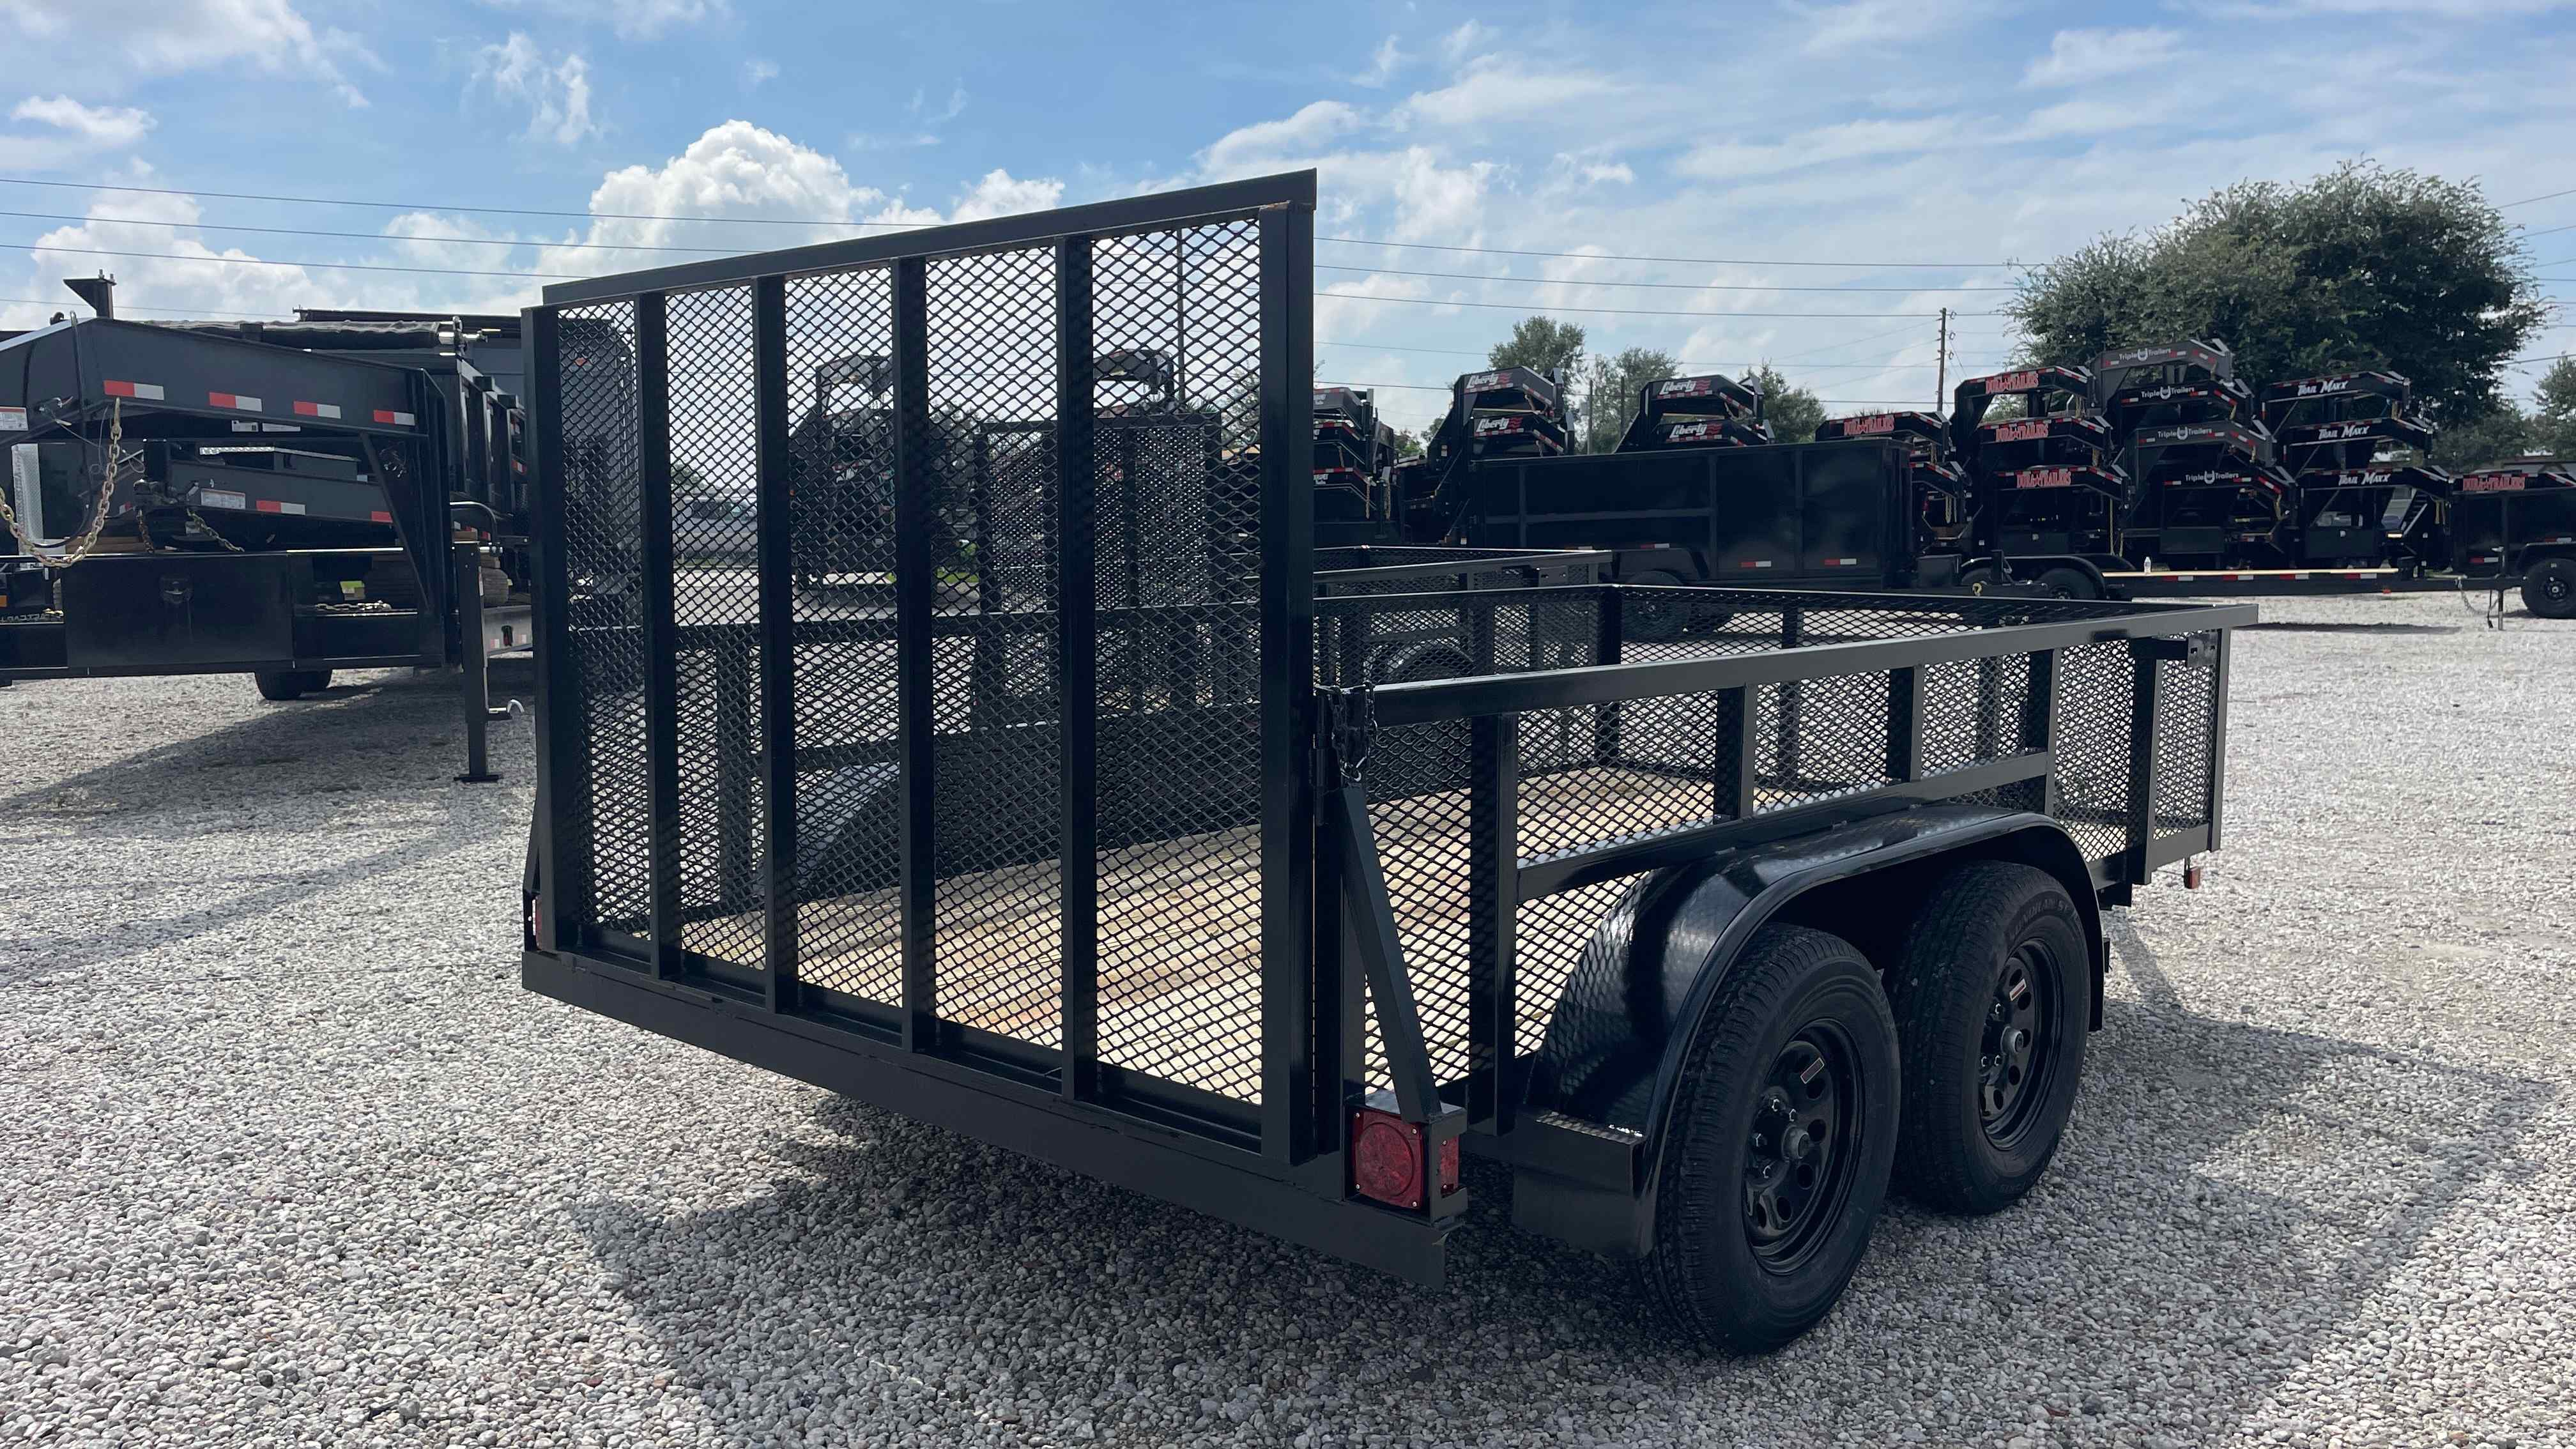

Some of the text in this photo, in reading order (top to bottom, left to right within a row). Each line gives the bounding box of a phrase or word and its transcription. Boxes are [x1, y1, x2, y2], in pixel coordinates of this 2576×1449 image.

[2119, 352, 2138, 360] Triple
[1466, 373, 1499, 388] Liberty
[1659, 379, 1697, 395] Liberty
[1476, 417, 1510, 432] Liberty
[1669, 423, 1707, 438] Liberty
[2158, 430, 2177, 438] Triple
[2185, 474, 2204, 482] Triple
